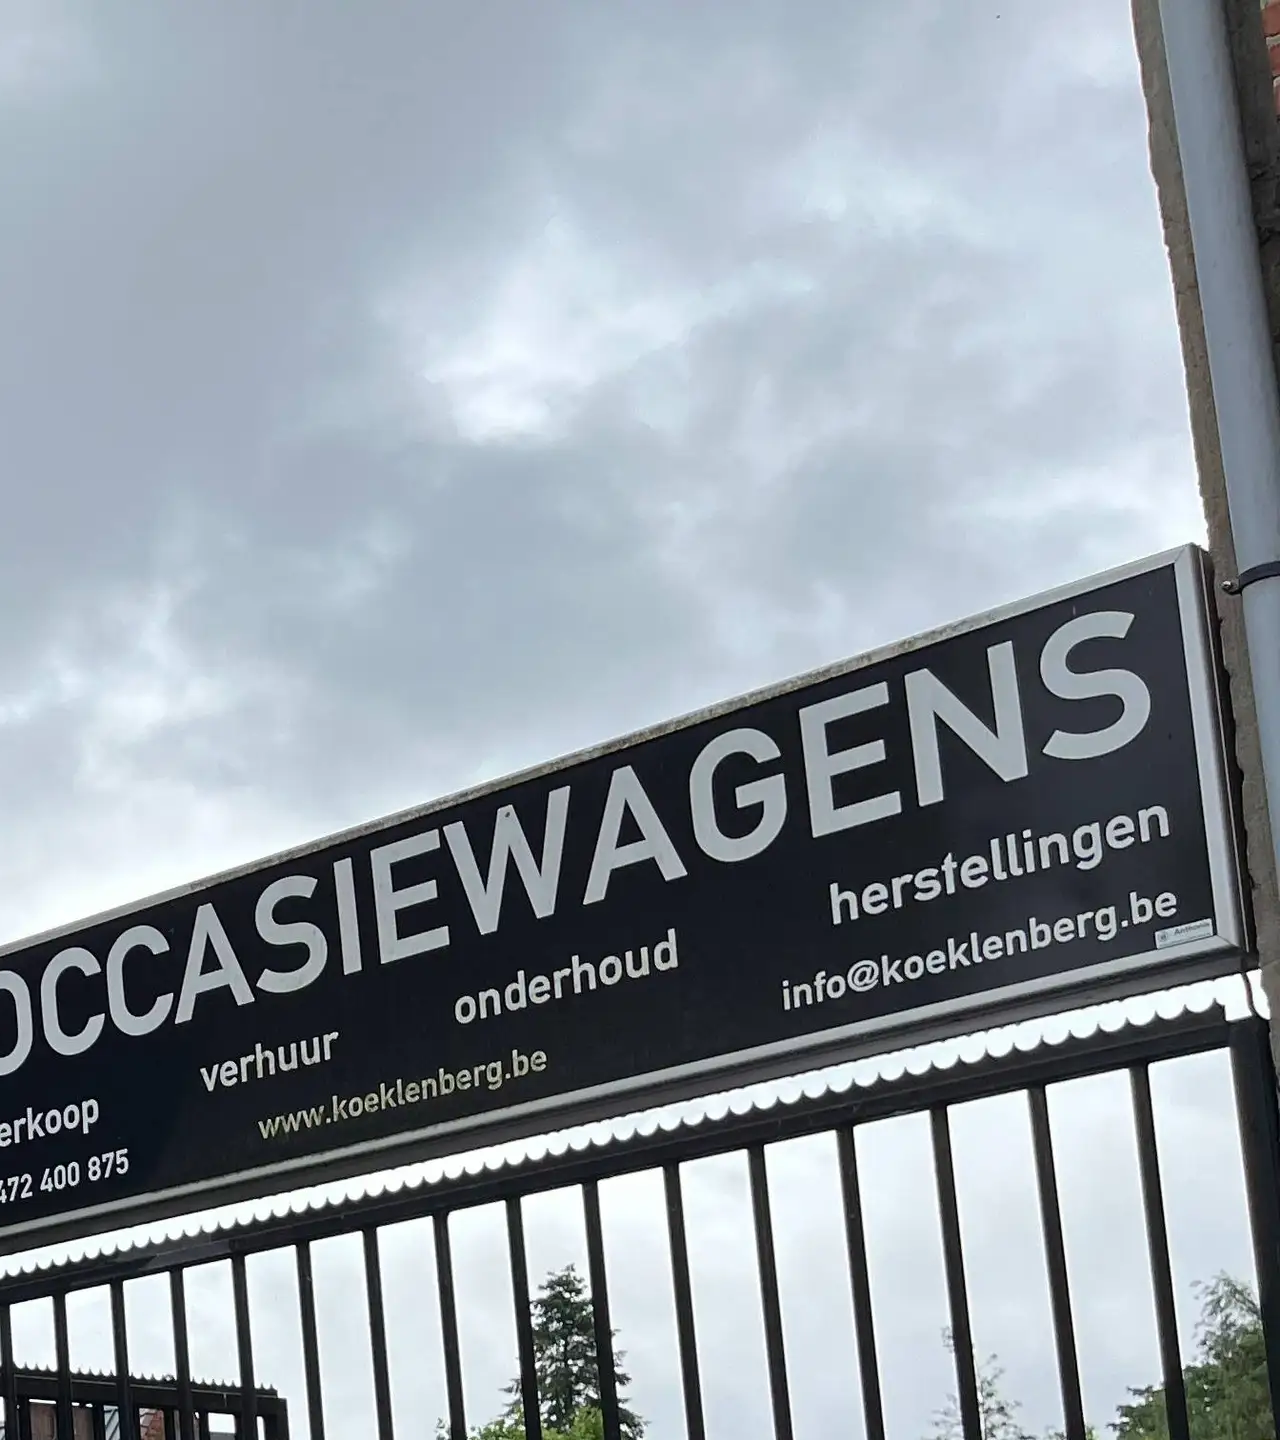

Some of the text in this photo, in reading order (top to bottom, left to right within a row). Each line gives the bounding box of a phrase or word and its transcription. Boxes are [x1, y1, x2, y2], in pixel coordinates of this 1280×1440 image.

[200, 1030, 340, 1092] verhuur
[454, 928, 679, 1024] onderhoud
[828, 804, 1171, 925] herstellingen
[781, 891, 1178, 1012] info@koeklenberg.be
[257, 1049, 548, 1140] www.koeklenberg.be
[40, 1161, 80, 1192] 400
[88, 1148, 130, 1181] 875
